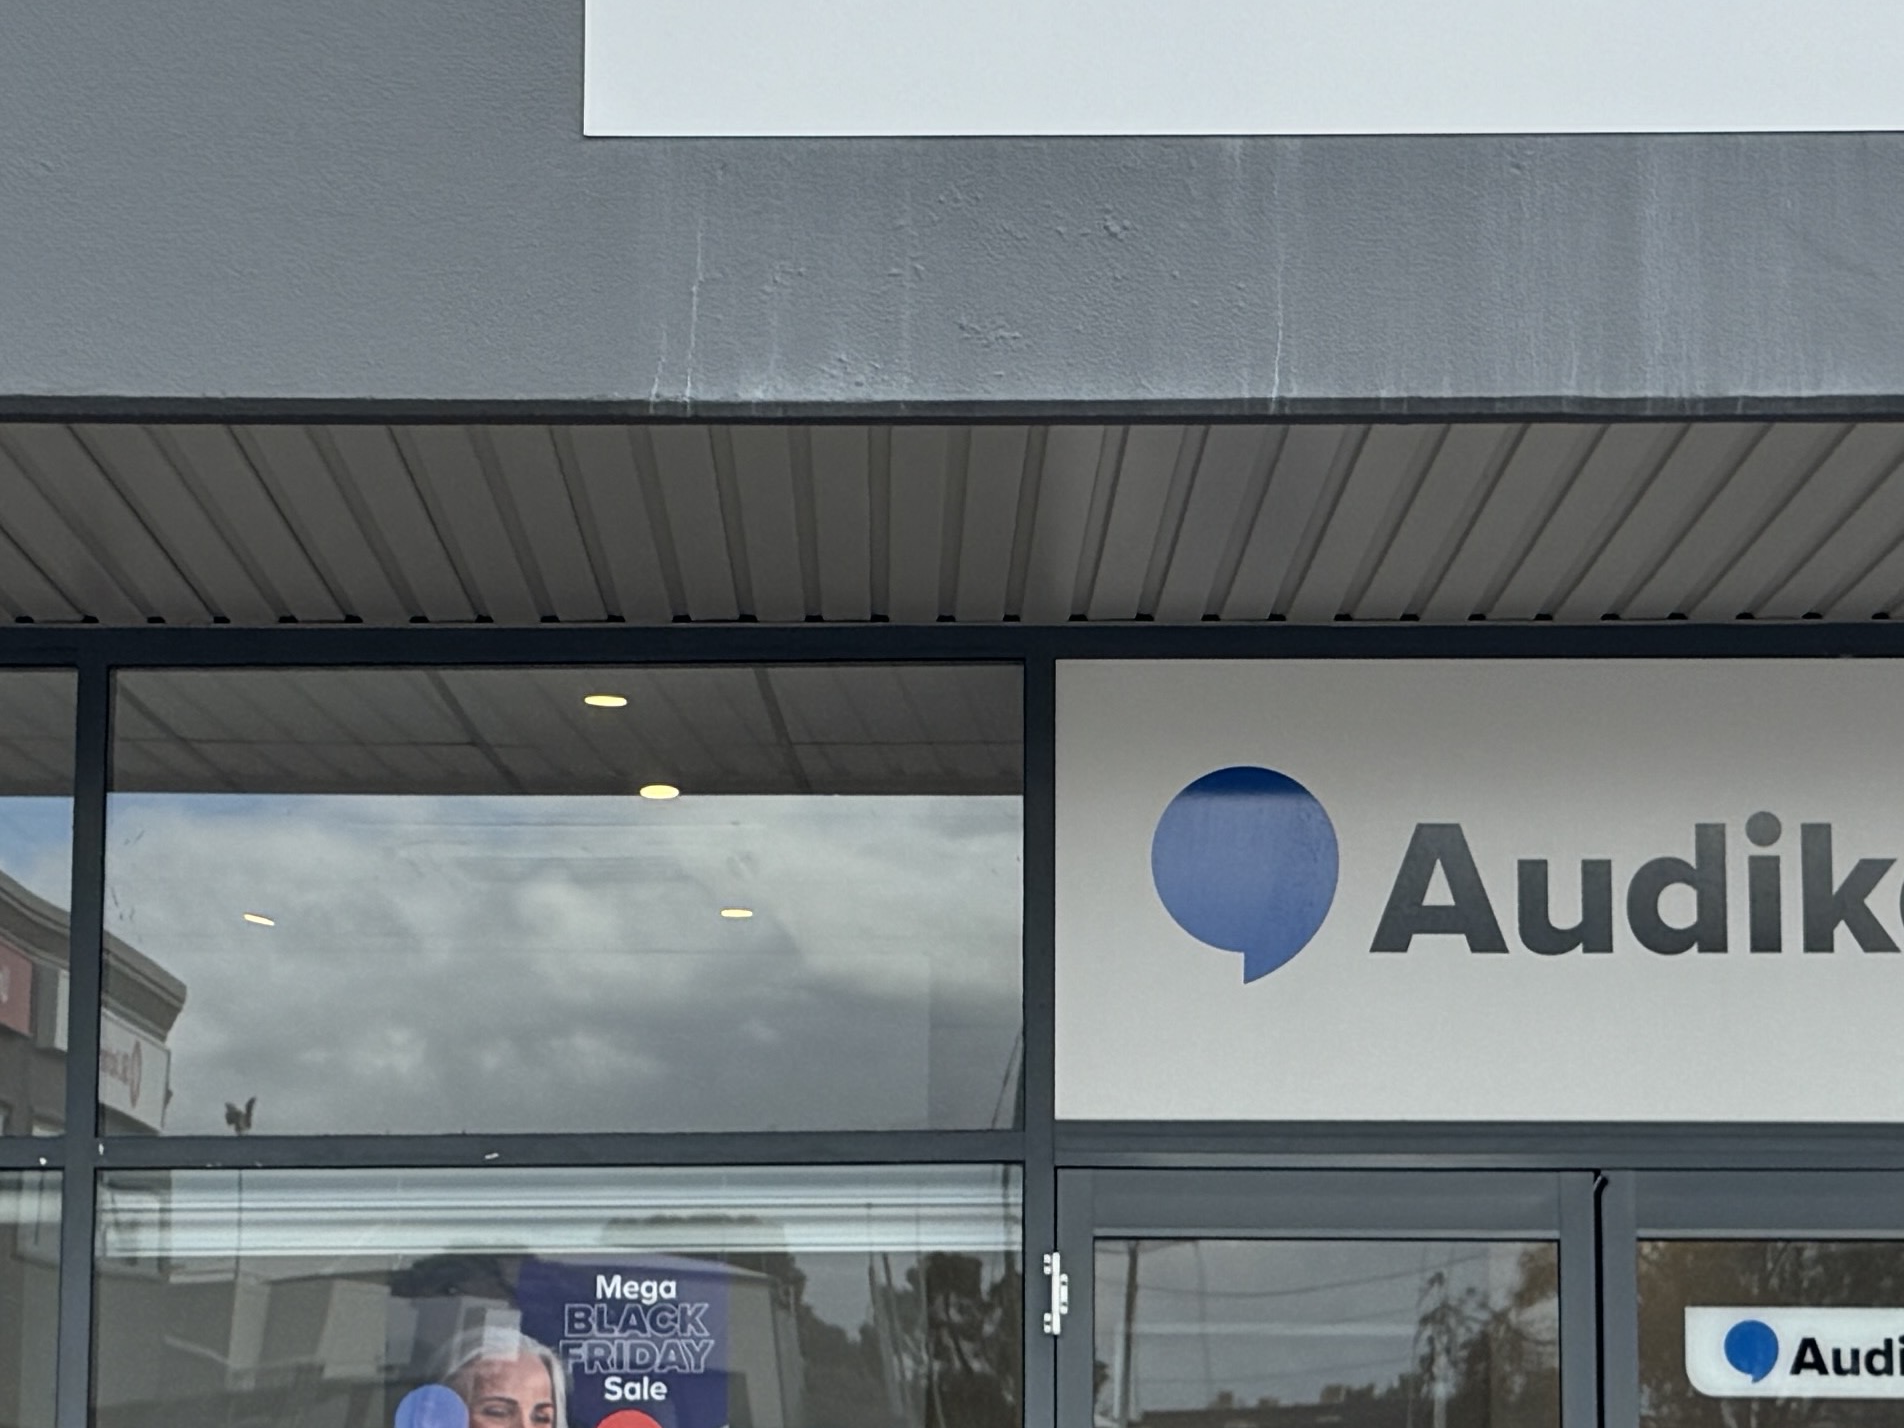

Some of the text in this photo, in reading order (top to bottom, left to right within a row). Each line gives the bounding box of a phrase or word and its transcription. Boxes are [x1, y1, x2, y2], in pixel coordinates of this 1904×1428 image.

[595, 1274, 677, 1305] Mega
[564, 1303, 709, 1337] BLACK
[559, 1338, 712, 1374] FRIDAY
[603, 1376, 668, 1402] Sale
